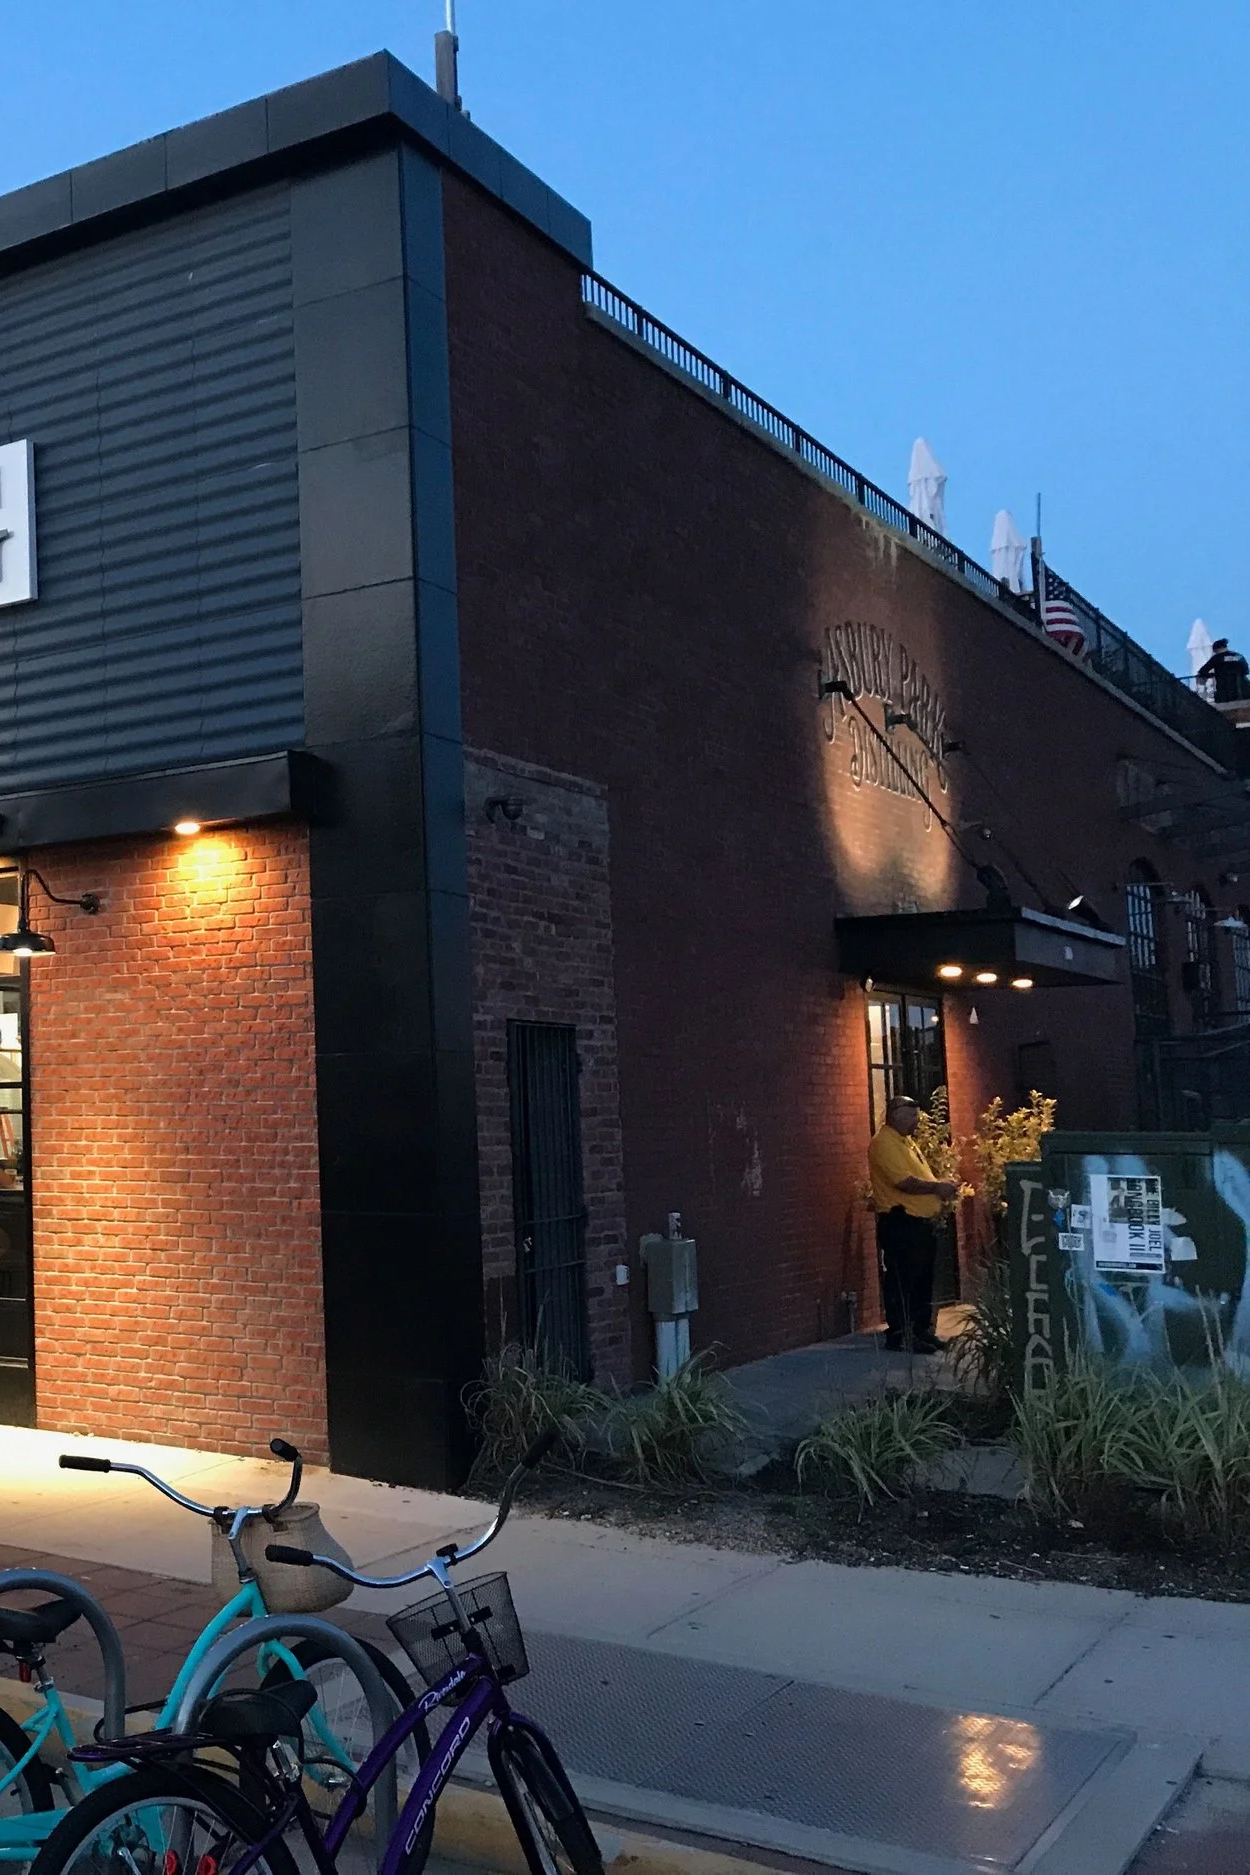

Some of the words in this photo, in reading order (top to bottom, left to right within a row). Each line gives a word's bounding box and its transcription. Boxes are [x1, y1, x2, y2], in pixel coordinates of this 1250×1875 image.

[1146, 1199, 1161, 1226] BILLY
[1148, 1228, 1162, 1252] JOEL
[404, 1715, 471, 1856] CONCORD
